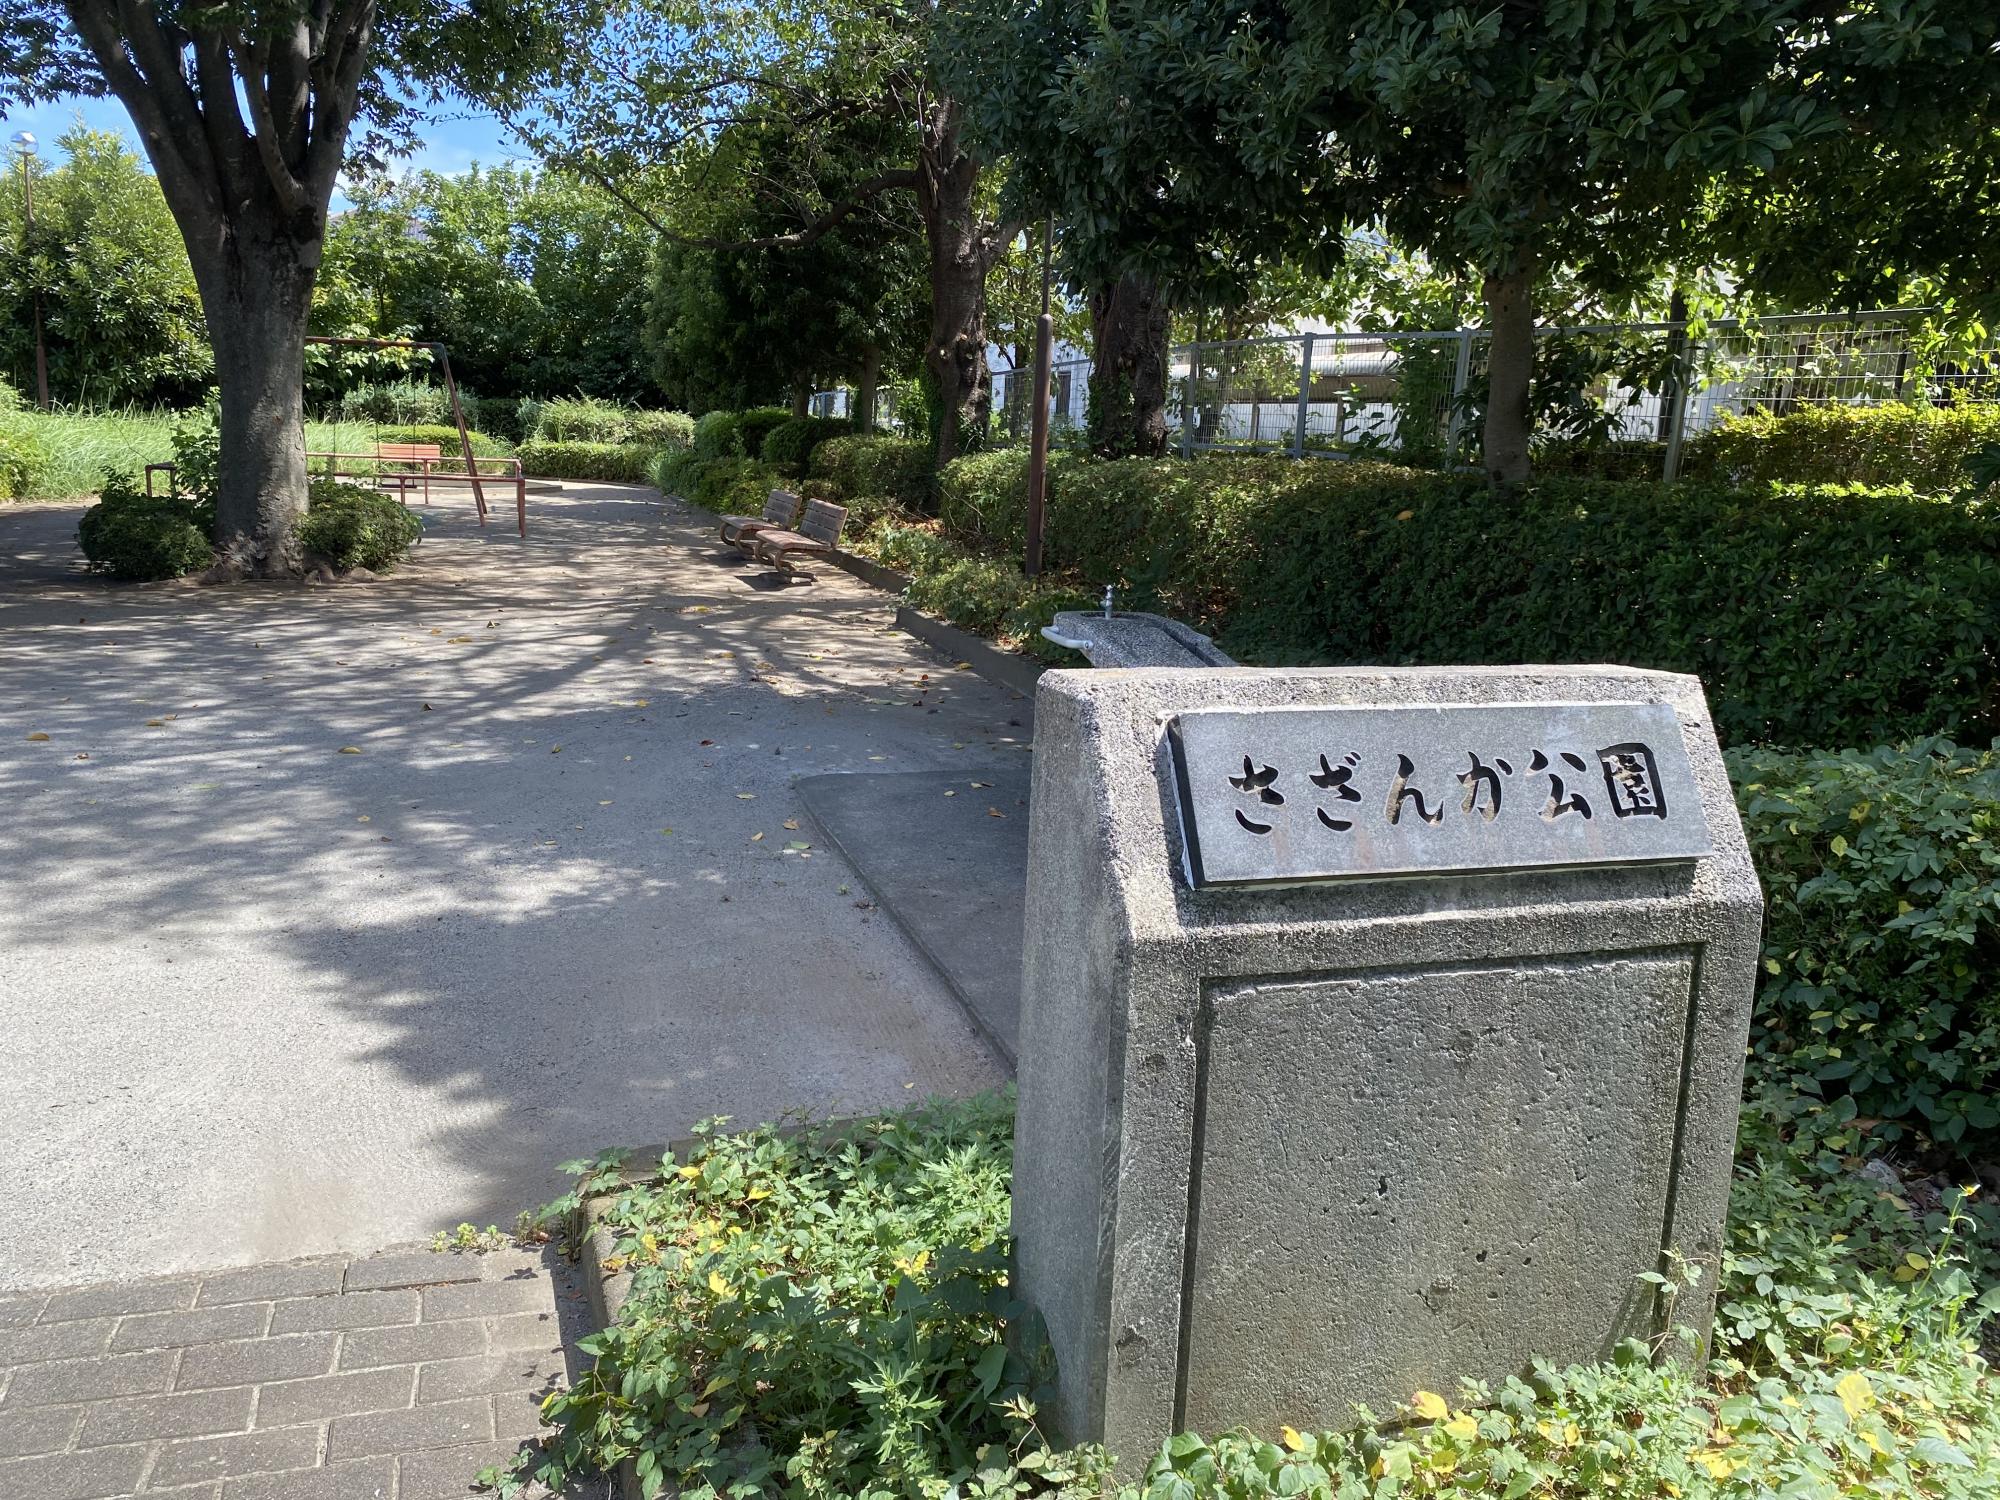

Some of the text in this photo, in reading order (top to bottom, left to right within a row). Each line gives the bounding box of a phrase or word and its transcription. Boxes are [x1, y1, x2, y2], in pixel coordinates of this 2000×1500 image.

[1228, 742, 1667, 835] さざんか公園
